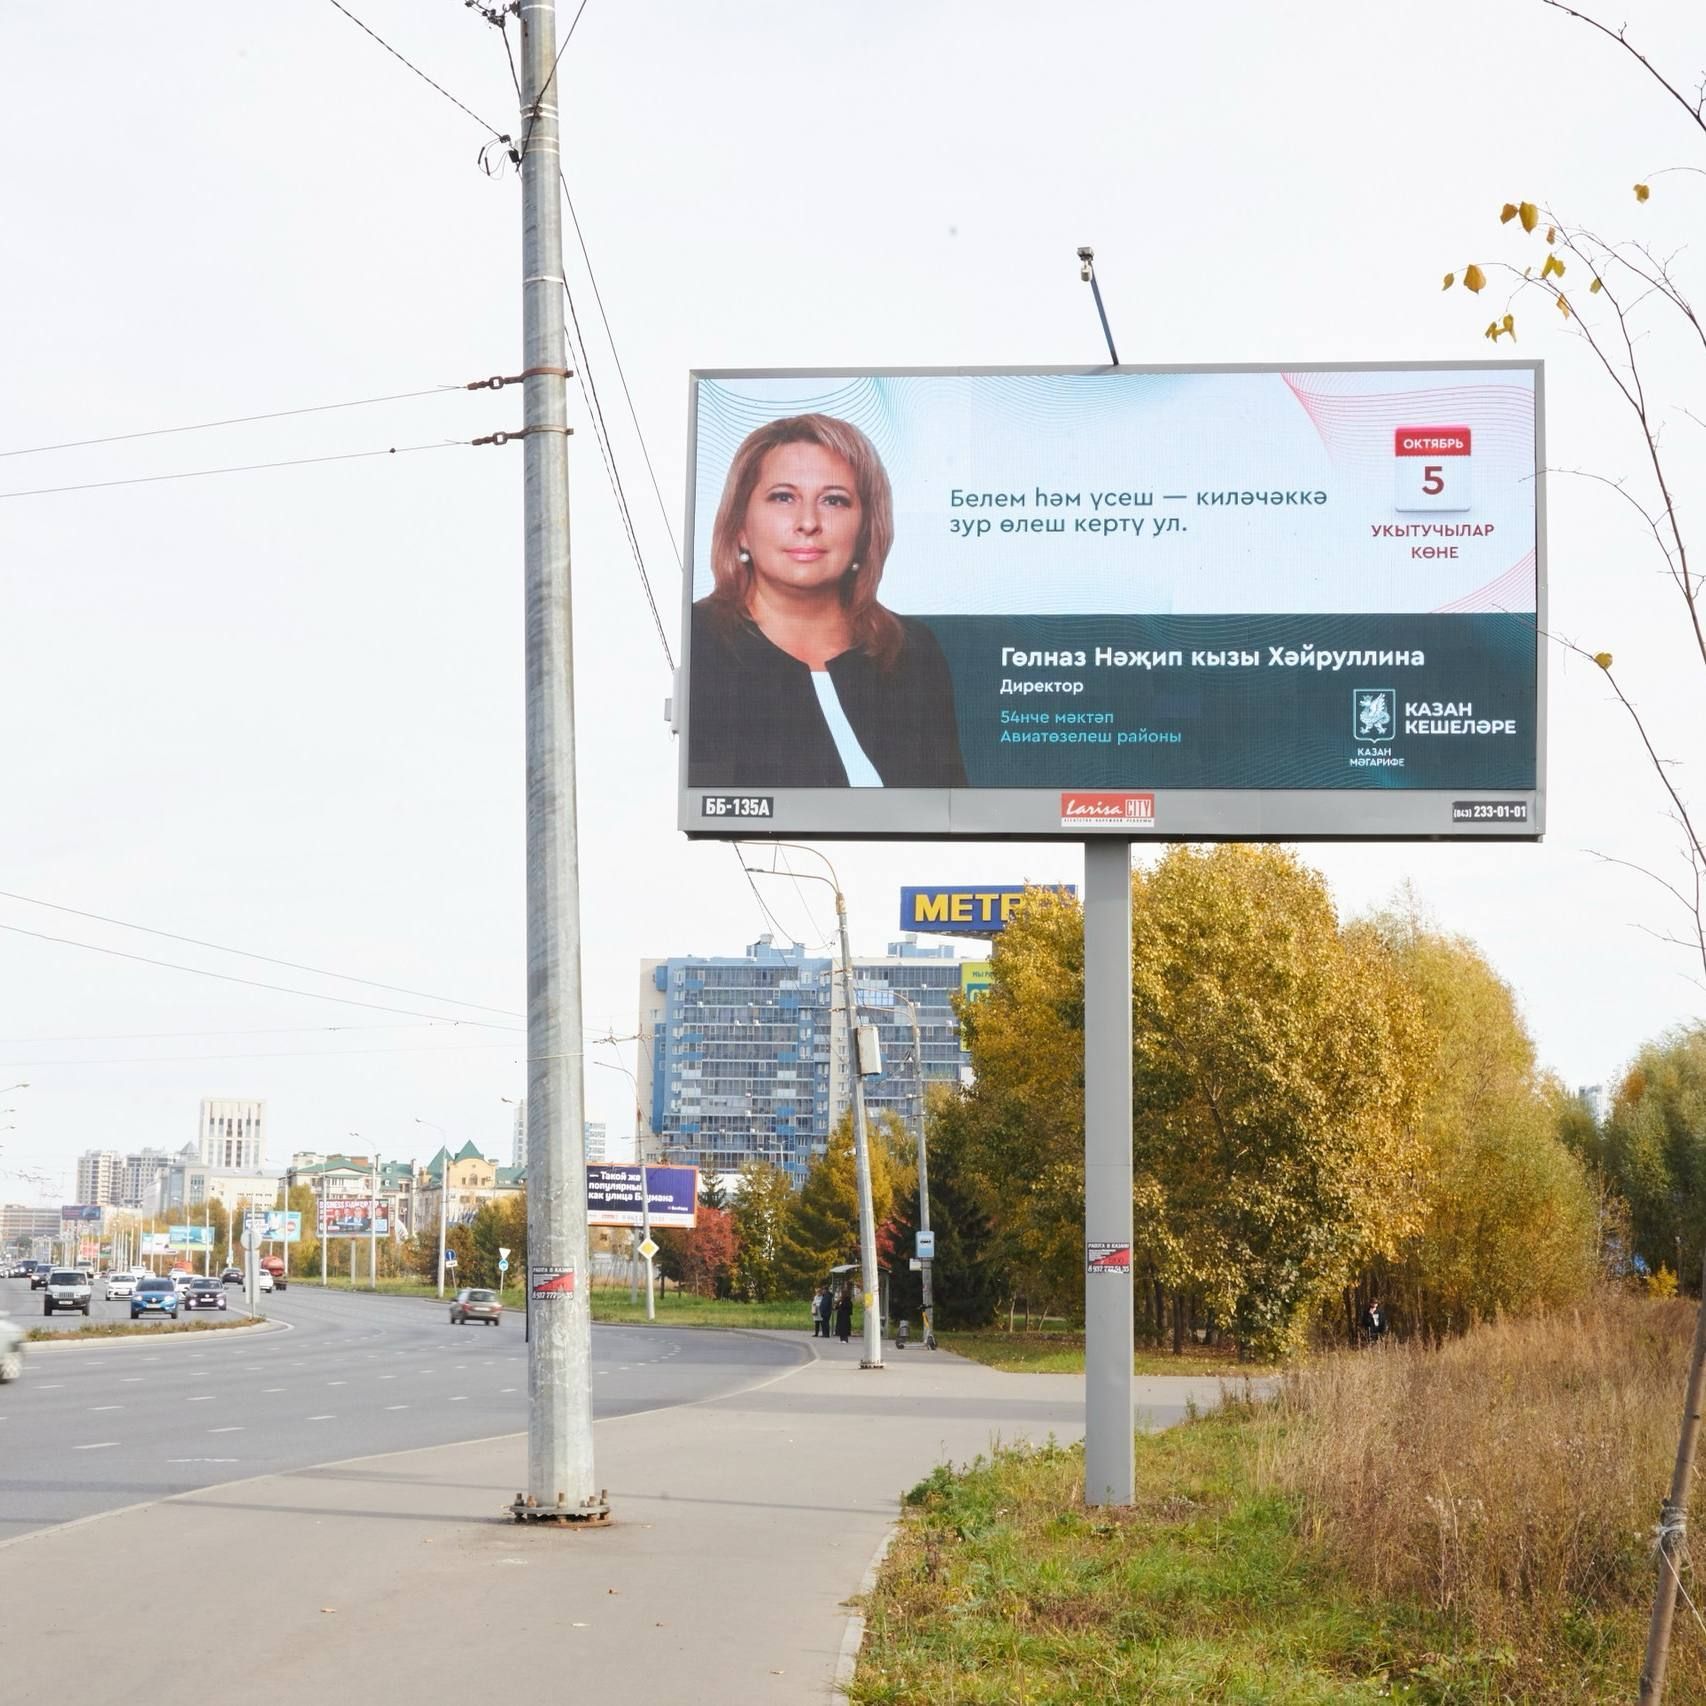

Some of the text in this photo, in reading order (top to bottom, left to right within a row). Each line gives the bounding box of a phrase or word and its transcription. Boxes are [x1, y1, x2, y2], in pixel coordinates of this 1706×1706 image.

[1403, 438, 1464, 449] ОКТЯБРЬ
[1422, 466, 1444, 495] 5
[950, 489, 1026, 507] Белем
[1035, 487, 1081, 507] һәм
[1090, 490, 1154, 512] үсеш
[1197, 489, 1328, 506] киләчәккә
[950, 516, 1187, 538] зур өлеш кертү ул.
[1371, 524, 1495, 537] УКЫТУЧЫЛАР
[1411, 546, 1459, 559] КӨНЕ
[1001, 644, 1425, 671] Гөлназ Нәҗип кызы Хәйруллина
[1000, 679, 1084, 696] Директор
[1405, 702, 1472, 717] КАЗАН
[1000, 710, 1114, 724] 54нче мәктәп
[1405, 720, 1517, 734] КЕШЕЛӘРЕ
[1000, 729, 1182, 746] Авиатөзелеш районы
[1357, 747, 1392, 756] КАЗАН
[1349, 758, 1405, 767] МӘГАРИФЕ
[705, 798, 770, 816] ББ-135А
[1066, 800, 1150, 816] Larisa CITY
[1453, 805, 1526, 818] (843) 233-01-01
[600, 1171, 627, 1181] Такой
[589, 1182, 642, 1192] популярны
[588, 1192, 674, 1203] как улица Бумана
